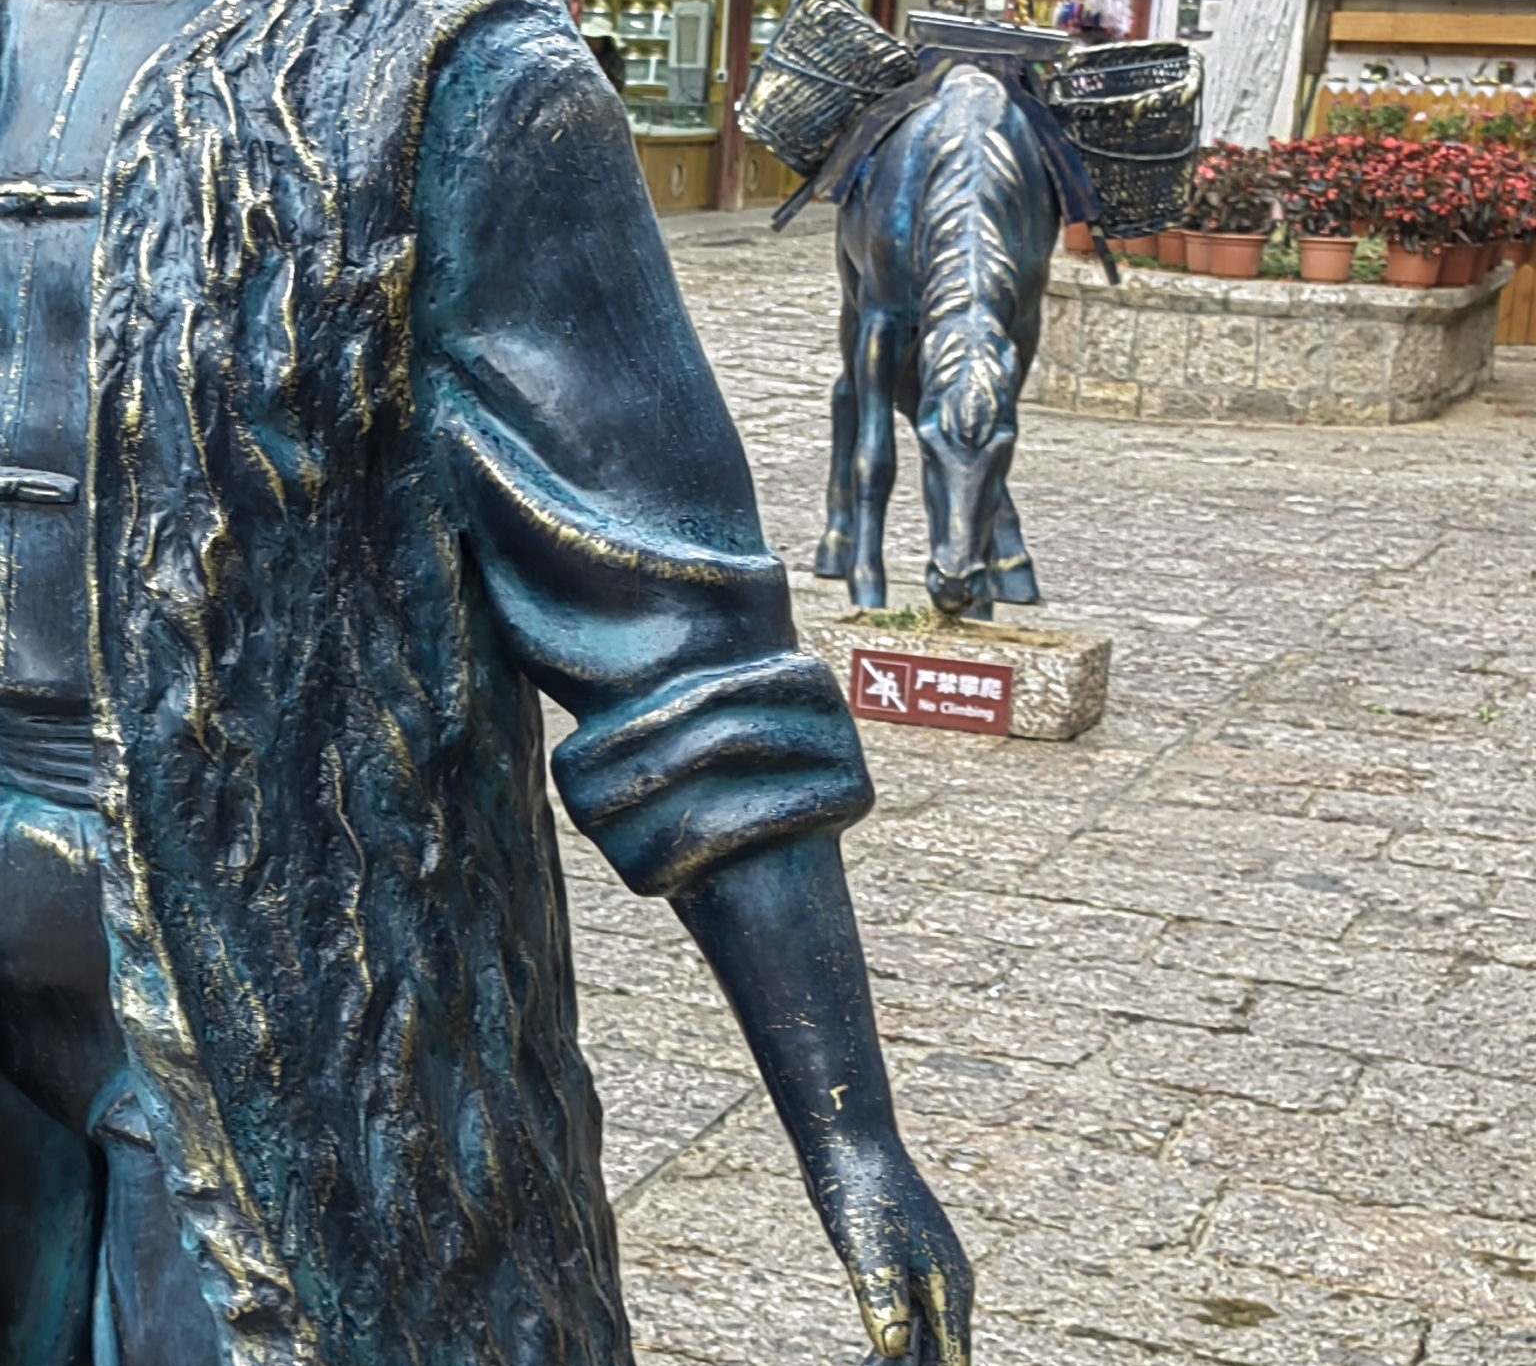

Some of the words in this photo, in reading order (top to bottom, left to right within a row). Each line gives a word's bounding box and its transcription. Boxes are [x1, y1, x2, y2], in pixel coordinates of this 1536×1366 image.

[914, 669, 1003, 700] 严禁攀爬
[917, 698, 937, 713] No
[939, 701, 995, 723] Climbing
